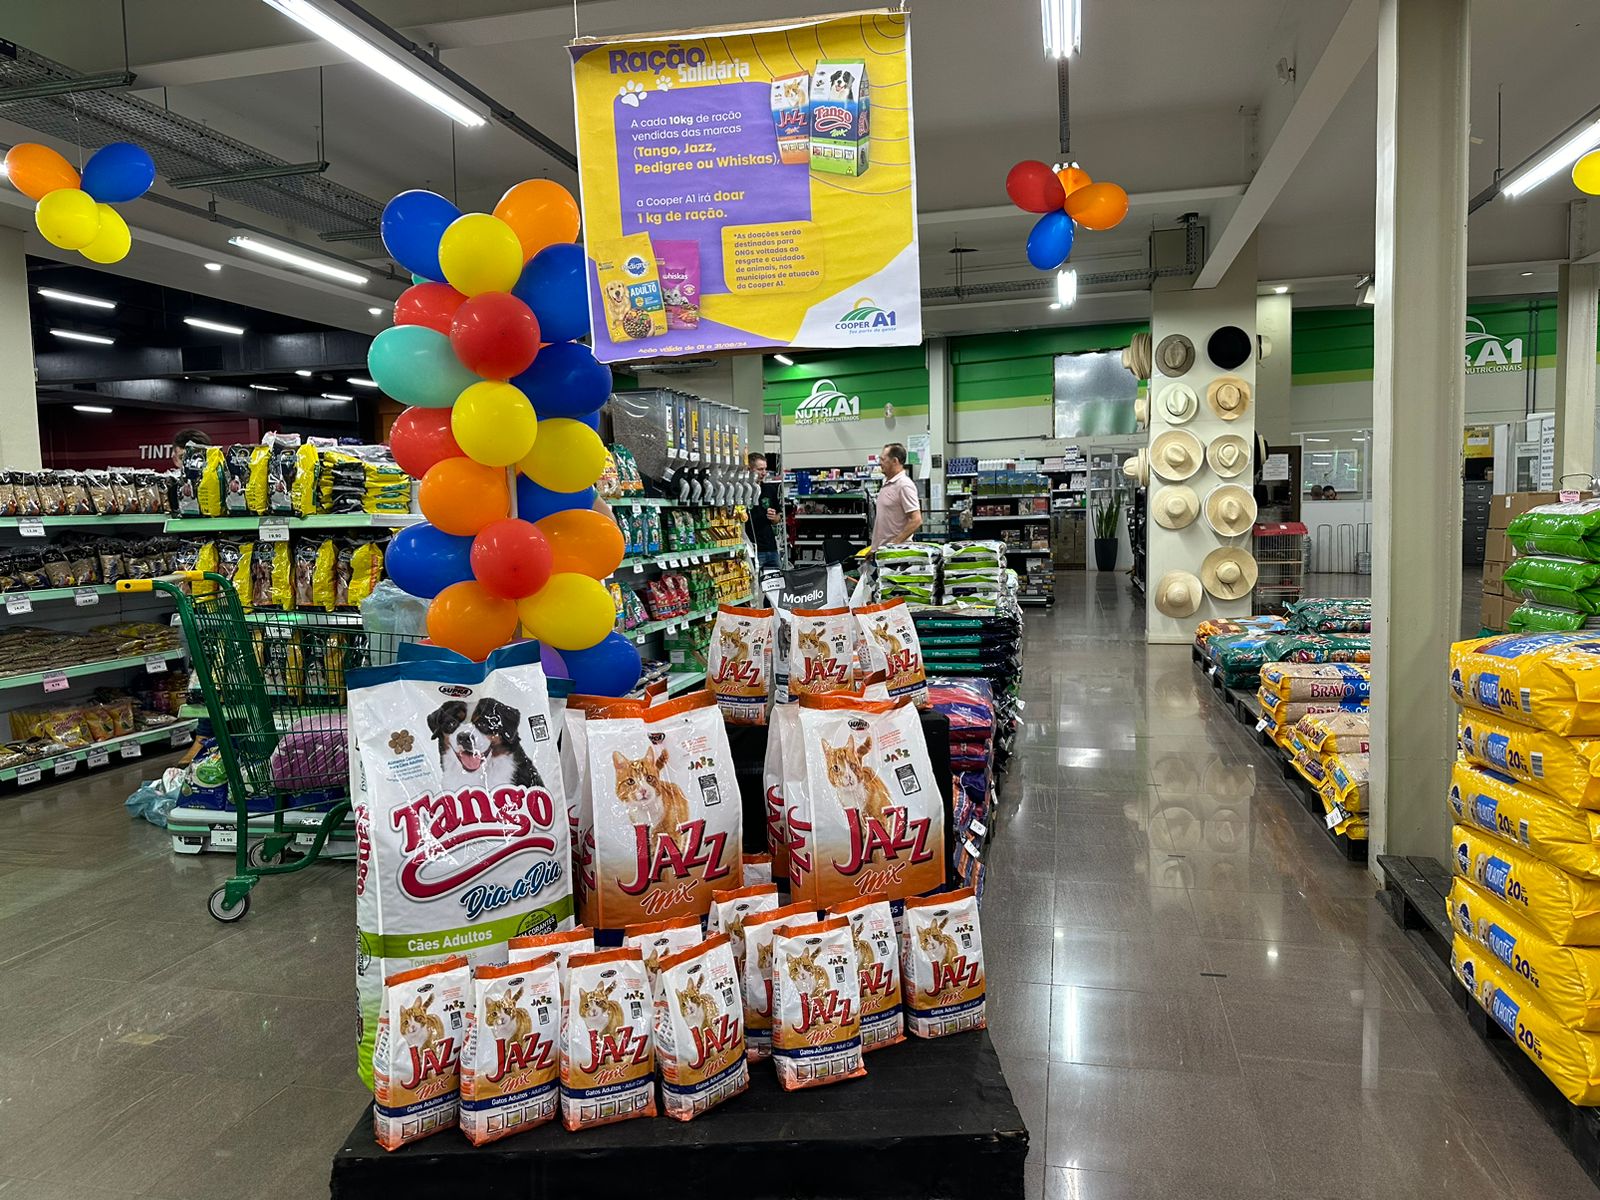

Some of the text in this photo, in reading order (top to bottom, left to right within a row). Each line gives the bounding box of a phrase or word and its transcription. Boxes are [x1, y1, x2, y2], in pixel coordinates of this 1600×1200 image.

[608, 43, 706, 75] Ração
[677, 57, 750, 83] Solidária
[630, 110, 742, 129] A cada 10kg de ração
[776, 109, 808, 128] JAZZ
[813, 105, 853, 124] Tango
[632, 124, 742, 142] vendidas das marcas
[633, 143, 717, 160] (Tango, Jazz,
[634, 151, 780, 175] Pedigree ou Whiskas),
[636, 190, 745, 209] a Cooper A1 irá doar
[636, 206, 728, 225] 1 kg de ração.
[734, 237, 794, 249] destinadas para
[747, 229, 780, 240] doações
[780, 228, 802, 237] serão
[734, 248, 754, 257] ONGs
[755, 245, 788, 255] voltadas
[735, 256, 764, 266] resgate
[770, 253, 805, 262] cuidados
[735, 262, 792, 273] de animais, nos
[736, 272, 776, 283] municípios
[788, 269, 820, 279] atuação
[629, 283, 657, 298] ADULTO
[747, 280, 774, 289] Cooper
[834, 310, 897, 330] COOPER A1
[1473, 337, 1523, 367] A1
[1464, 363, 1522, 375] NUTRICIONAIS
[795, 395, 860, 420] NUTRI A1
[782, 588, 824, 604] Monello
[711, 656, 761, 688] JAZZ
[798, 656, 849, 686] JAZZ
[885, 648, 921, 681] JAZZ
[441, 686, 470, 696] SUPRA
[1310, 682, 1356, 699] BRAVO
[1500, 687, 1511, 707] 20
[687, 755, 716, 771] JAZZ
[883, 748, 911, 763] JAZZ
[1508, 749, 1521, 769] 20
[393, 785, 555, 854] Tango
[1498, 812, 1511, 834] 20
[831, 805, 935, 876] JAZZ
[615, 818, 731, 897] JAZZ
[854, 862, 908, 896] mix
[459, 860, 562, 921] Dia-a-Dia
[640, 878, 700, 916] mix
[1507, 878, 1521, 900] 20
[871, 930, 890, 941] JAZZ
[954, 923, 974, 934] JAZZ
[407, 930, 493, 952] Cães Adultos
[827, 955, 849, 966] JAZZ
[1514, 954, 1530, 980] 20
[859, 961, 897, 999] AZZ
[924, 955, 982, 998] JAZZ
[530, 995, 553, 1007] JAZZ
[623, 989, 645, 1000] JAZZ
[442, 999, 466, 1012] JAZZ
[792, 988, 856, 1035] JAZZ
[688, 1013, 742, 1071] JAZZ
[1518, 1023, 1534, 1050] 20
[485, 1031, 555, 1084] JAZZ
[579, 1025, 650, 1075] JAZZ
[601, 1084, 622, 1095] Adultos
